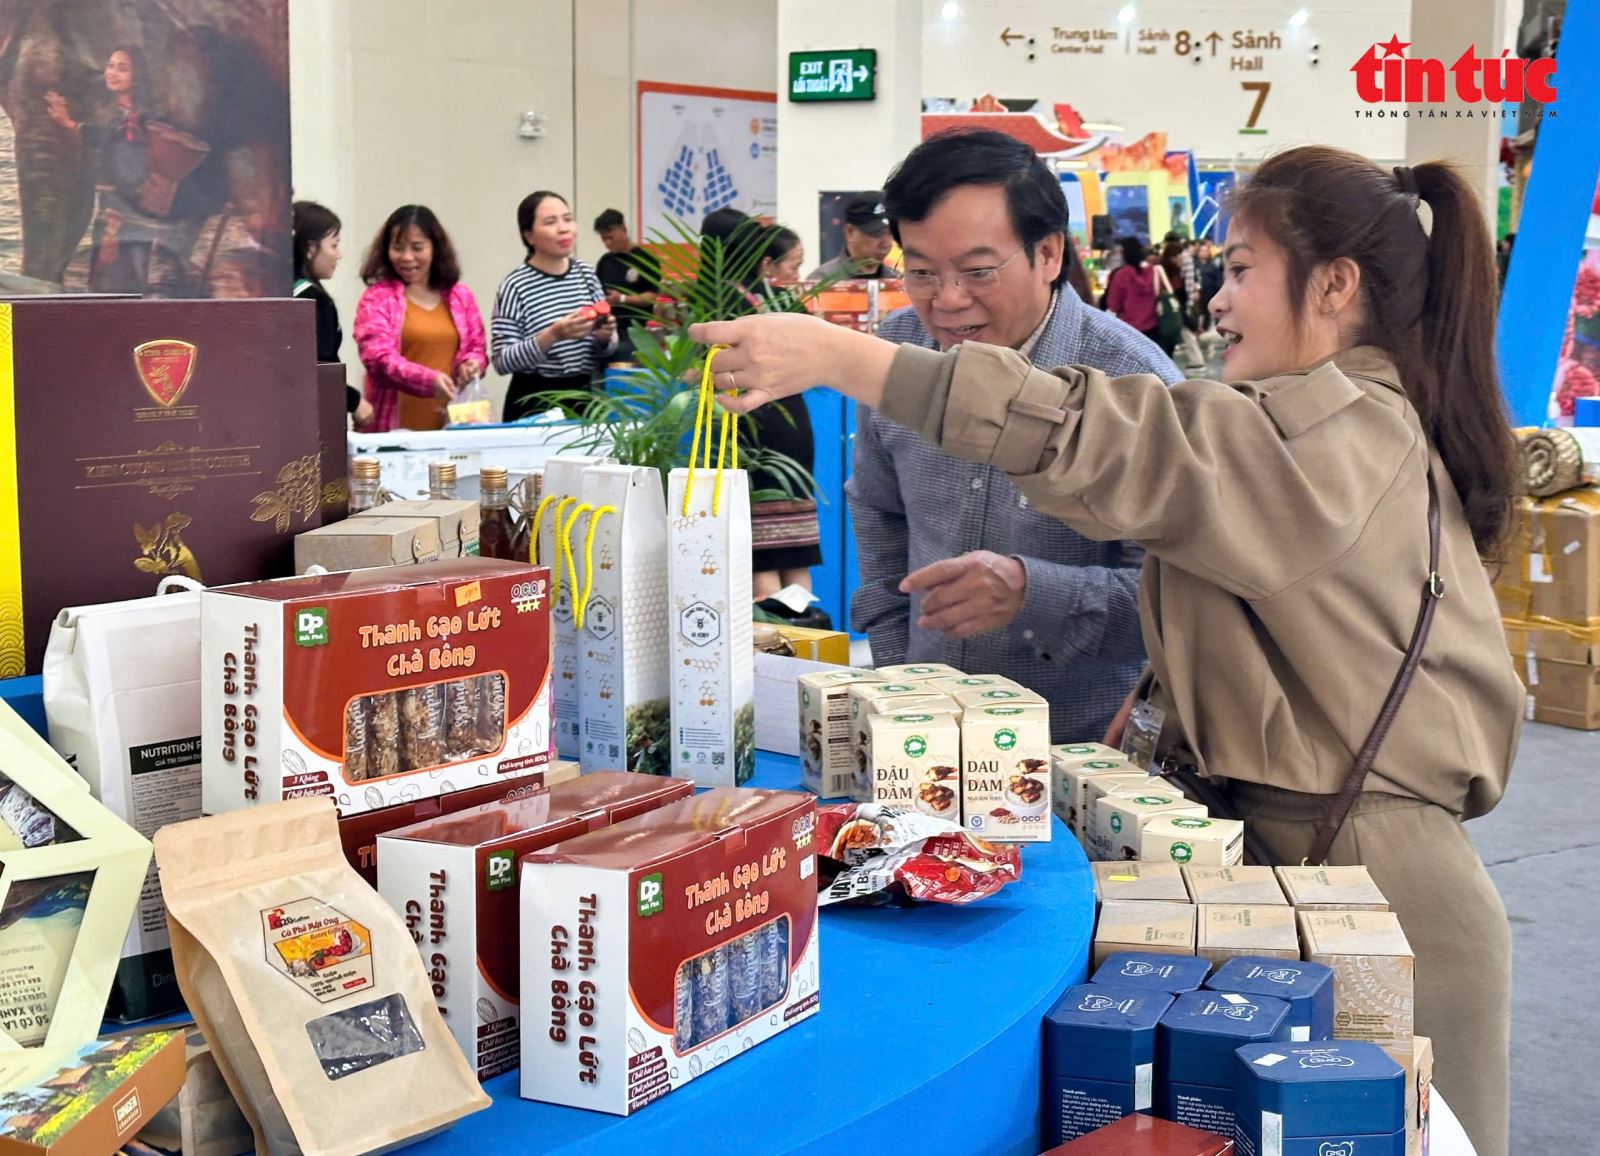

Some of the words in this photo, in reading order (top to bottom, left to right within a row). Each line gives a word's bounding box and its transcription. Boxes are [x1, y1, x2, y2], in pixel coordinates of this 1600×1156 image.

[1051, 44, 1082, 54] Center
[1084, 44, 1104, 54] Hall
[1052, 27, 1089, 42] Trung
[1175, 30, 1192, 56] 8
[1231, 30, 1282, 50] Sảnh
[800, 61, 824, 75] EXIT
[1231, 56, 1263, 72] Hall
[1240, 81, 1271, 128] 7
[511, 580, 546, 600] OCOP
[299, 613, 324, 634] DP
[358, 619, 422, 649] Thanh
[426, 615, 463, 641] Gạo
[467, 605, 502, 632] Lứt
[223, 652, 239, 695] Chà
[244, 623, 258, 696] Thanh
[428, 643, 476, 671] Bông
[222, 703, 239, 762] Bông
[241, 704, 258, 748] Gạo
[140, 742, 194, 759] NUTRITION
[967, 760, 999, 773] DAU
[244, 756, 260, 800] Lứt
[967, 779, 1003, 792] DAM
[490, 857, 511, 877] DP
[685, 871, 730, 910] Thanh
[732, 861, 759, 890] Gạo
[762, 847, 787, 877] Lứt
[429, 869, 447, 945] Thanh
[641, 880, 660, 902] DP
[735, 890, 769, 923] Bông
[551, 925, 571, 971] Chà
[578, 893, 597, 972] Thanh
[427, 953, 447, 998] Gạo
[549, 980, 571, 1043] Bông
[575, 980, 597, 1027] Gạo
[3, 1020, 18, 1030] LA
[579, 1036, 600, 1084] Lứt
